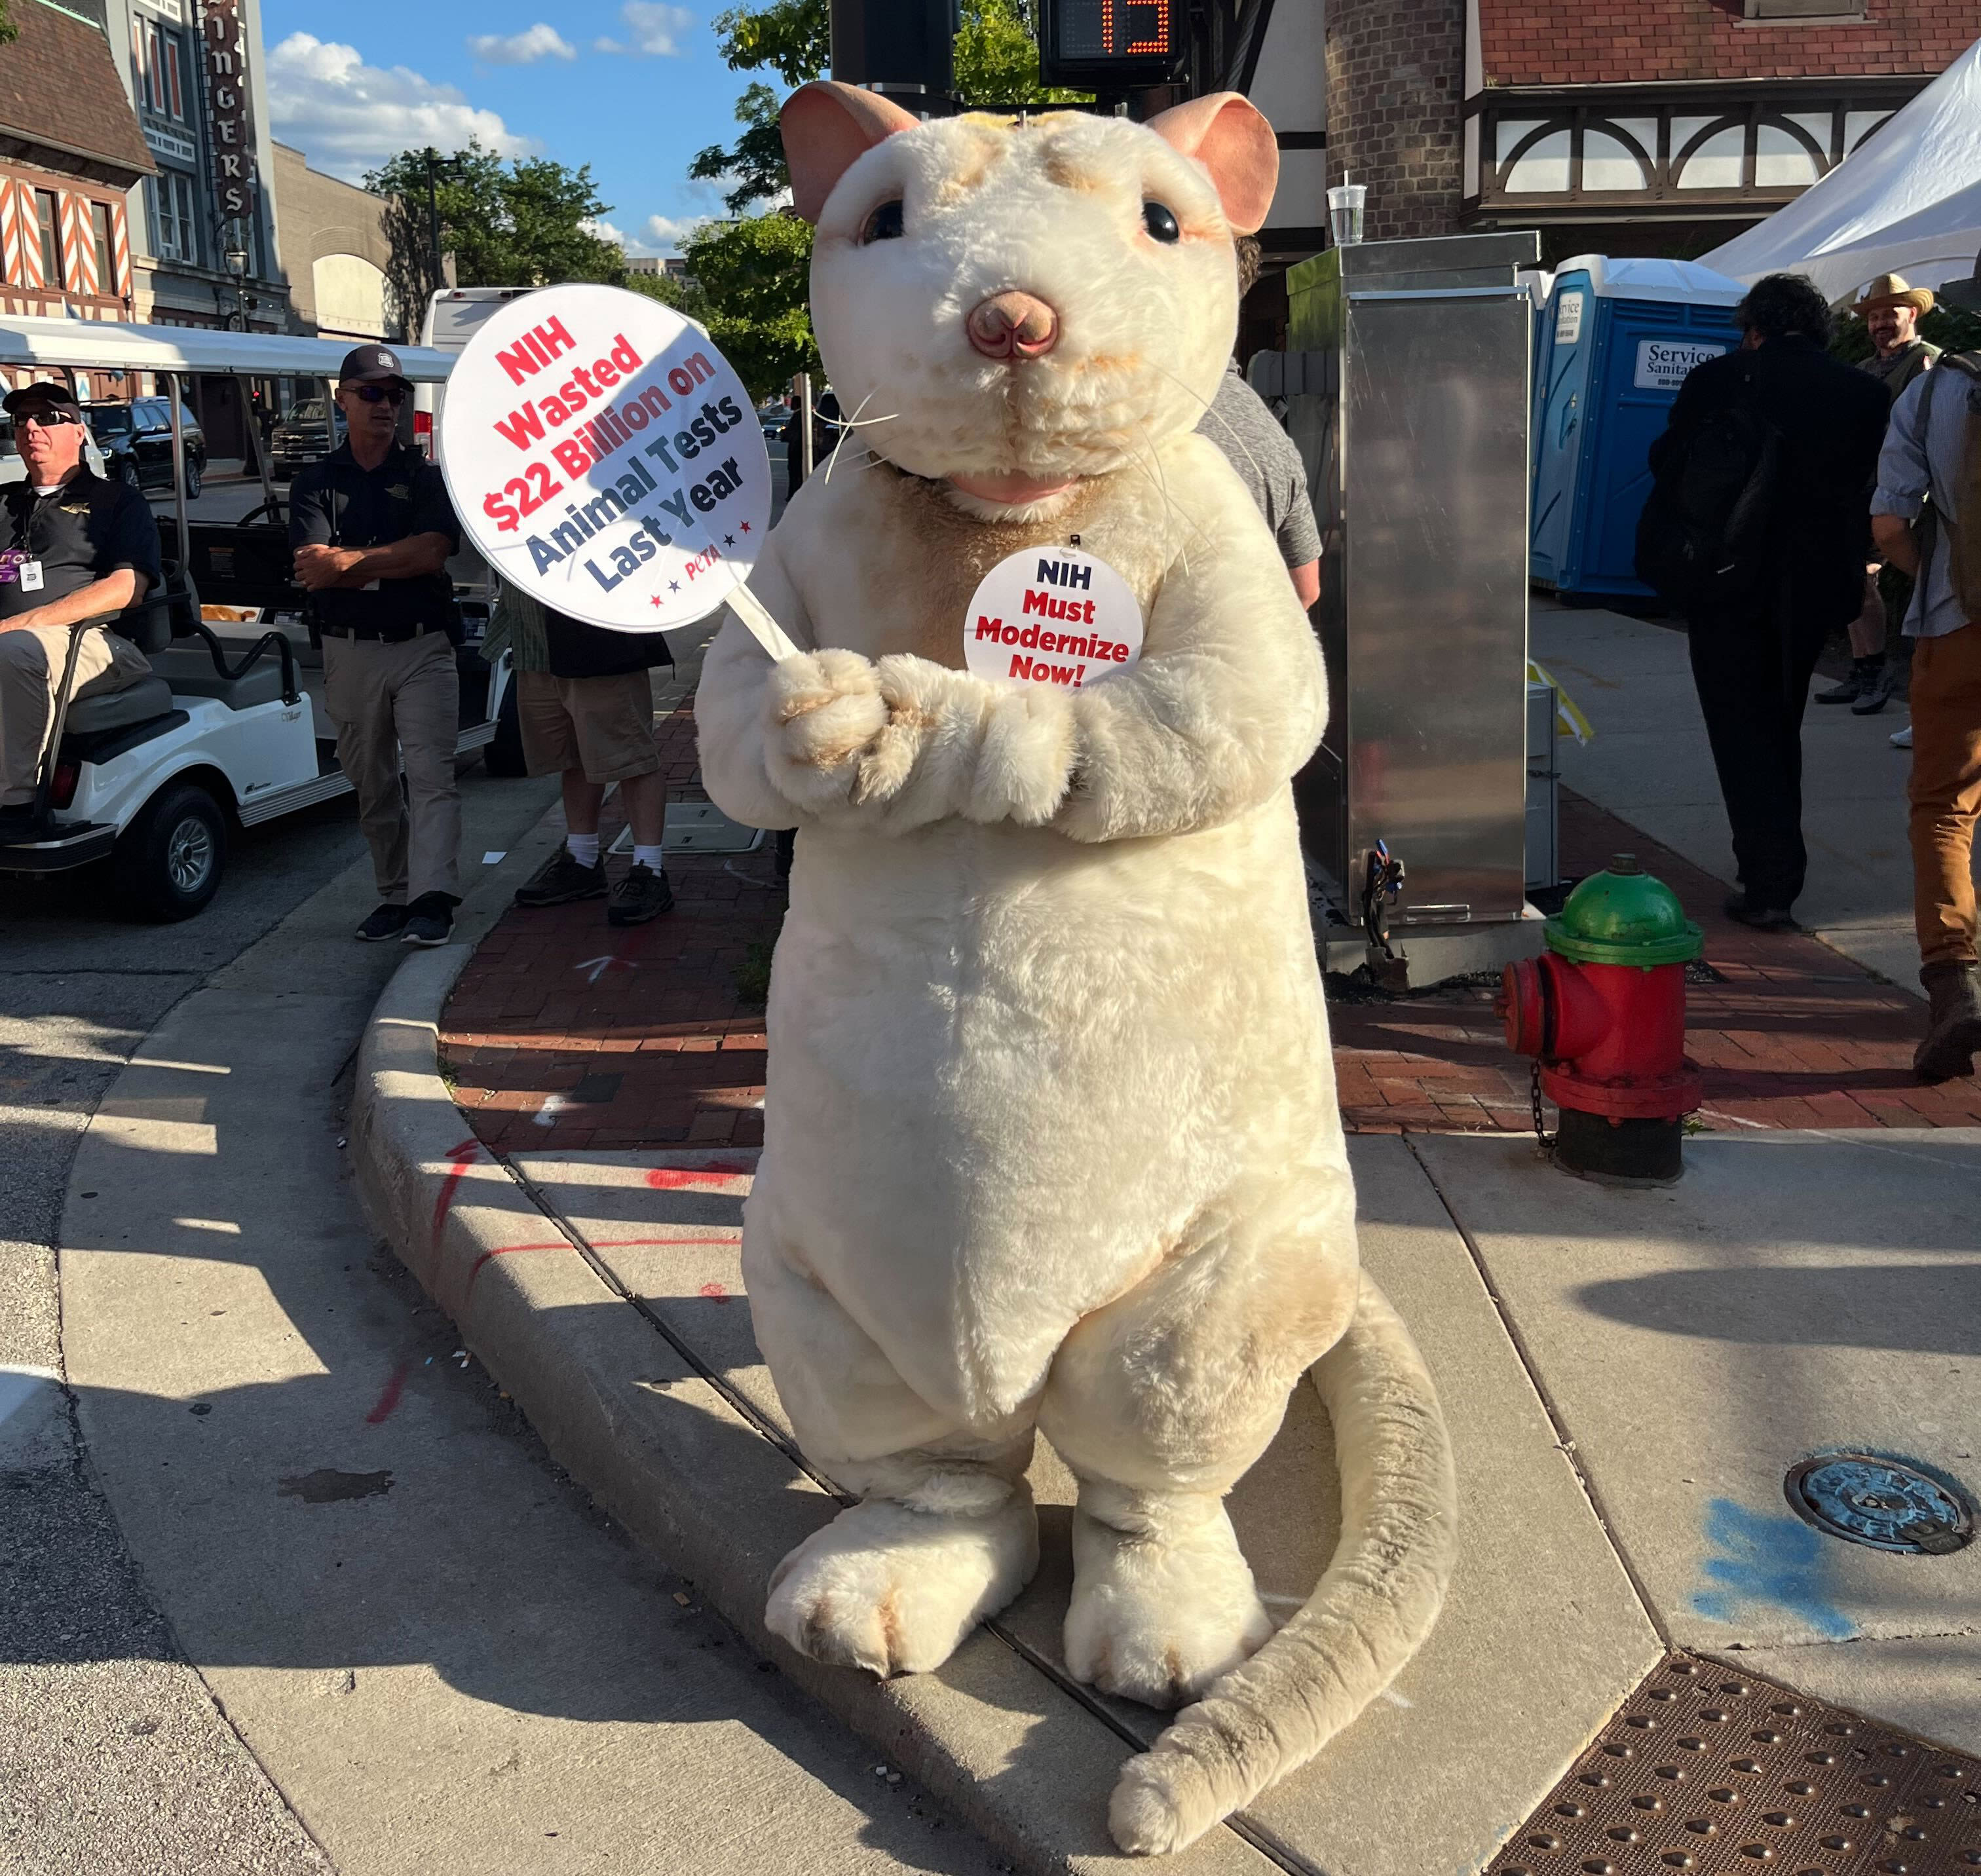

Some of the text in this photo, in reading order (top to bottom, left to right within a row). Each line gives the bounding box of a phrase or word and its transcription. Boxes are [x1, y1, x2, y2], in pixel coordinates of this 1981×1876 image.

[495, 315, 577, 386] NIH
[1648, 345, 1714, 364] Service
[493, 333, 643, 451] Wasted
[483, 352, 717, 533] $22 Billion on
[525, 395, 743, 576] Animal Tests
[584, 456, 744, 593] Last Year
[1036, 559, 1092, 590] NIH
[1022, 589, 1096, 624] Must
[975, 616, 1129, 663] Modernize
[1008, 654, 1085, 687] Now!
